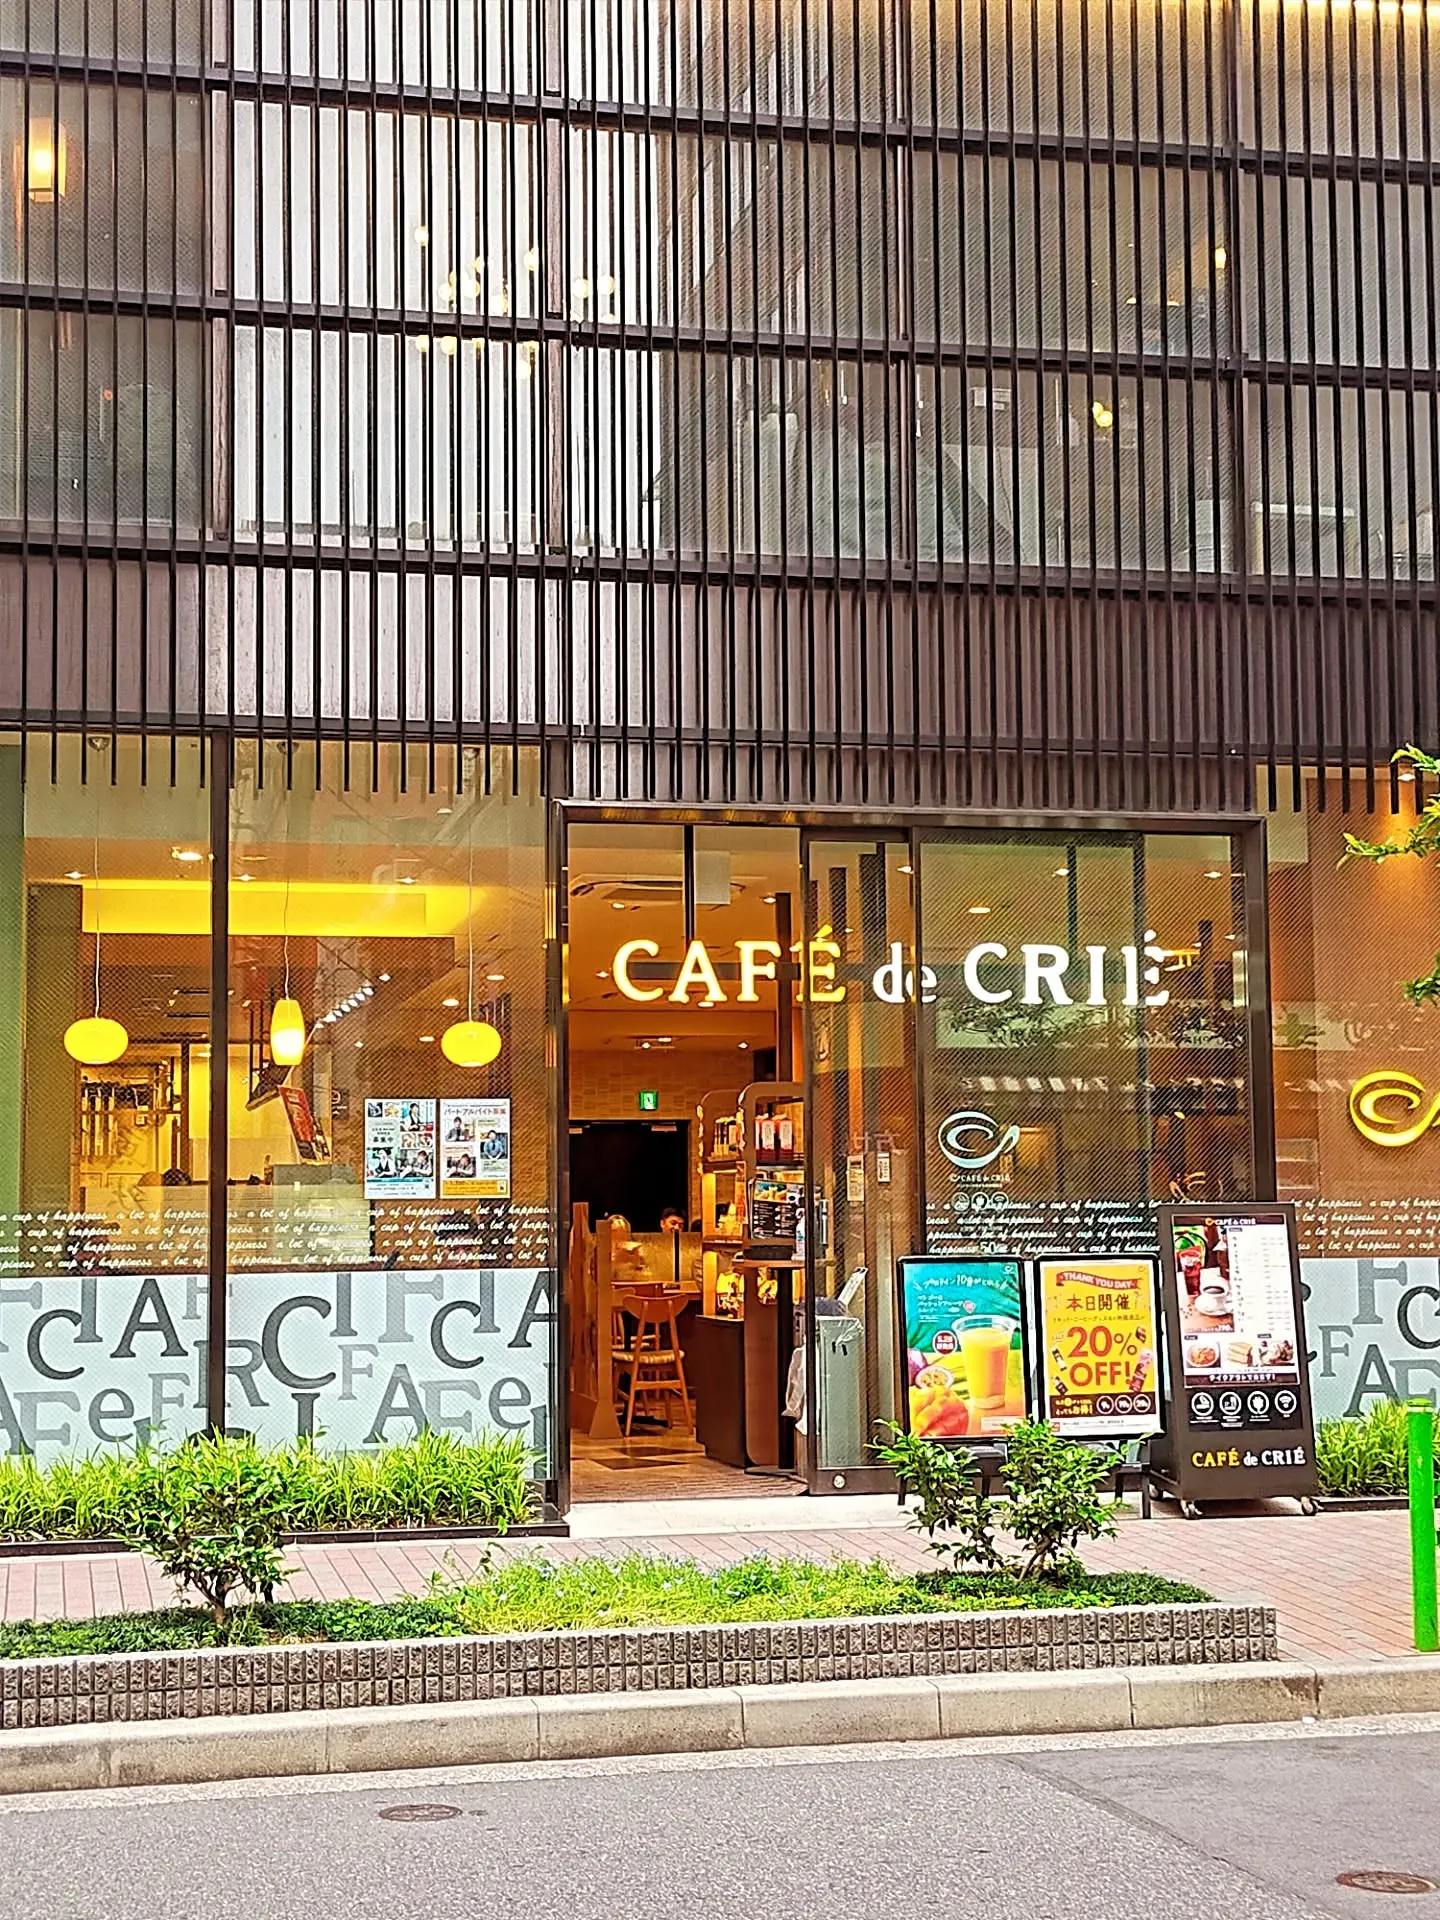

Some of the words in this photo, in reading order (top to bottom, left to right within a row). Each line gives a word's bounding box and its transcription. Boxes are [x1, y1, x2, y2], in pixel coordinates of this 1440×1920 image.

[613, 924, 846, 1002] CAFÉ
[872, 942, 937, 1002] de
[965, 929, 1170, 1006] CRIÉ
[367, 1208, 385, 1219] cup
[389, 1206, 401, 1219] of
[404, 1205, 455, 1218] happiness
[494, 1205, 505, 1219] of
[1050, 1202, 1067, 1211] cup
[1071, 1200, 1081, 1212] of
[1085, 1199, 1130, 1211] happiness
[1305, 1198, 1316, 1210] of
[1318, 1198, 1363, 1209] happiness
[1380, 1200, 1397, 1209] cup
[1400, 1198, 1411, 1210] of
[12, 1212, 33, 1229] cup
[37, 1211, 49, 1224] of
[53, 1210, 108, 1227] happiness
[149, 1210, 161, 1223] of
[279, 1208, 290, 1222] of
[985, 1215, 995, 1227] of
[1063, 1216, 1081, 1225] cup
[1084, 1214, 1094, 1226] of
[1098, 1213, 1143, 1225] happiness
[1318, 1213, 1328, 1224] of
[1331, 1212, 1375, 1223] happiness
[1393, 1214, 1409, 1223] cup
[1412, 1213, 1423, 1224] of
[28, 1228, 47, 1241] cup
[53, 1227, 64, 1239] of
[69, 1226, 122, 1241] happiness
[163, 1225, 176, 1237] of
[293, 1223, 305, 1236] of
[381, 1224, 399, 1235] cup
[404, 1221, 415, 1235] of
[419, 1221, 469, 1235] happiness
[508, 1220, 519, 1233] of
[999, 1228, 1009, 1241] of
[1012, 1228, 1058, 1240] happiness
[1077, 1230, 1093, 1240] cup
[1097, 1228, 1107, 1240] of
[1110, 1228, 1156, 1239] happiness
[1331, 1227, 1341, 1239] of
[1344, 1226, 1388, 1238] happiness
[1405, 1228, 1422, 1238] cup
[1425, 1227, 1436, 1239] of
[42, 1244, 63, 1258] cup
[67, 1243, 81, 1256] of
[83, 1242, 137, 1257] happiness
[177, 1241, 190, 1253] of
[308, 1238, 319, 1251] of
[395, 1238, 413, 1249] cup
[417, 1237, 429, 1251] of
[433, 1236, 483, 1250] happiness
[522, 1235, 533, 1248] of
[1089, 1245, 1106, 1255] cup
[1111, 1243, 1120, 1255] of
[1344, 1240, 1354, 1252] of
[1357, 1240, 1401, 1251] happiness
[1419, 1241, 1436, 1251] cup
[58, 1260, 77, 1273] cup
[83, 1259, 95, 1271] of
[99, 1257, 153, 1272] happiness
[193, 1257, 207, 1269] of
[230, 1254, 282, 1267] happiness
[322, 1253, 333, 1265] of
[337, 1252, 388, 1266] happiness
[409, 1253, 427, 1264] cup
[433, 1251, 444, 1264] of
[448, 1251, 498, 1265] happiness
[536, 1249, 547, 1264] of
[1064, 1272, 1094, 1282] THANK
[1095, 1278, 1113, 1288] YOU
[1114, 1281, 1132, 1289] DAY
[1066, 1294, 1131, 1311] 本日開催
[1067, 1325, 1137, 1358] 20%
[1069, 1361, 1131, 1387] OFF!
[1192, 1448, 1240, 1467] CAFÉ
[1243, 1451, 1258, 1466] de
[1261, 1446, 1306, 1465] CRIÉ
